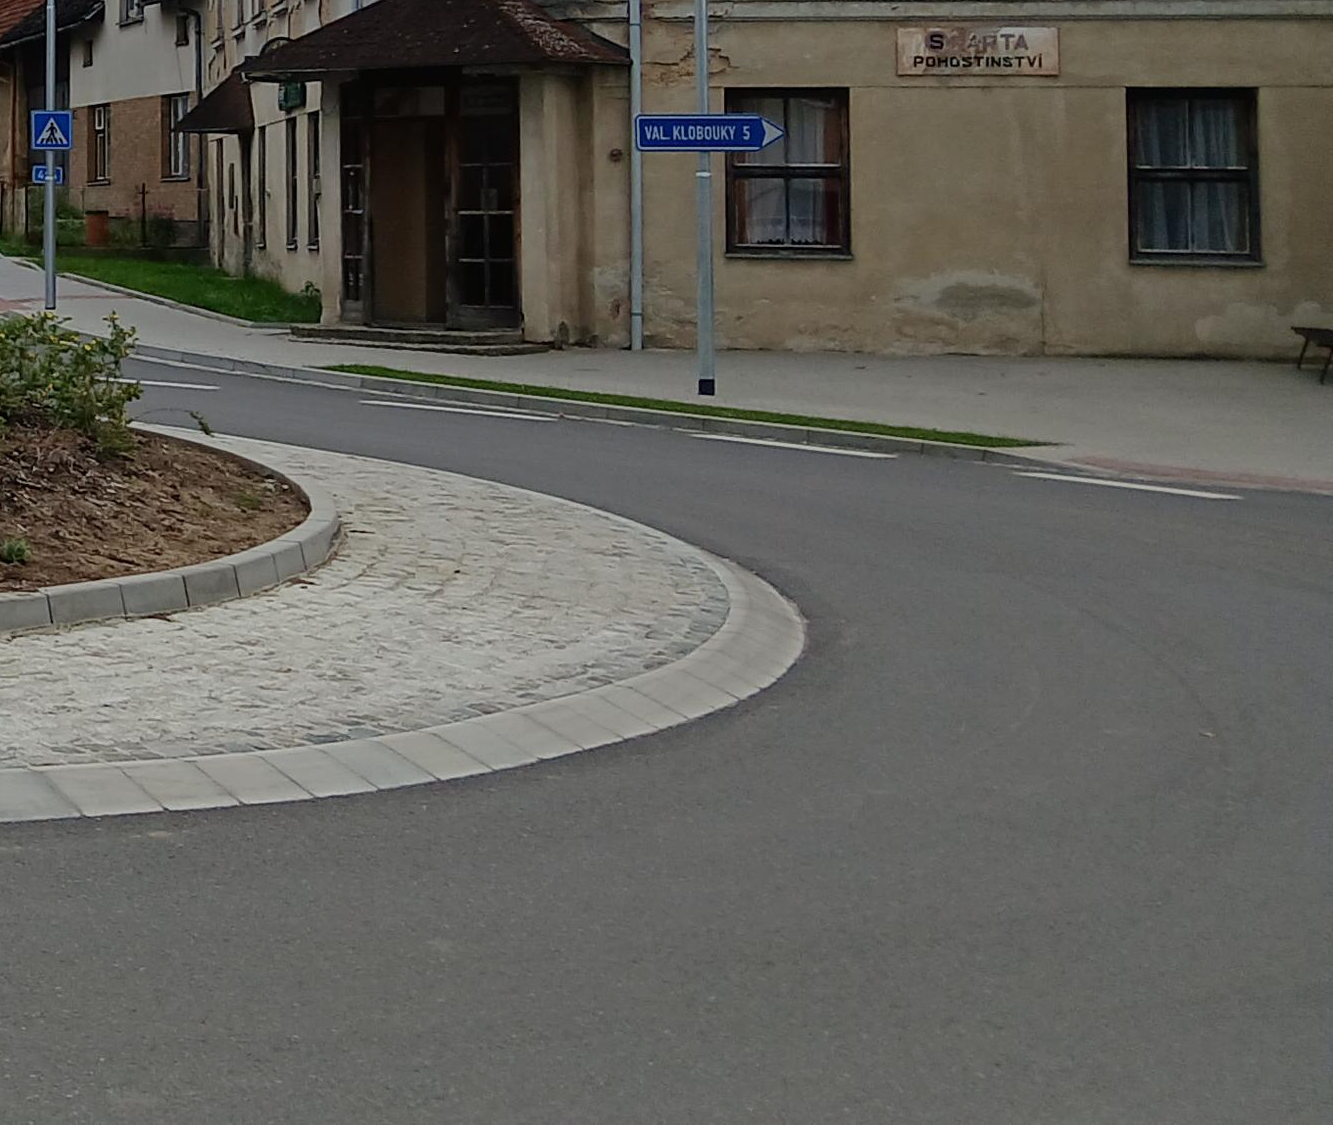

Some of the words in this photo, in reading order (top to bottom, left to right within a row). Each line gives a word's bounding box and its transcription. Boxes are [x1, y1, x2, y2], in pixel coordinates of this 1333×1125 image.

[926, 33, 1029, 52] SARTA
[913, 53, 1043, 68] POHOSTINSTVÍ
[673, 125, 736, 140] KLOBOUKY
[742, 125, 750, 140] 5
